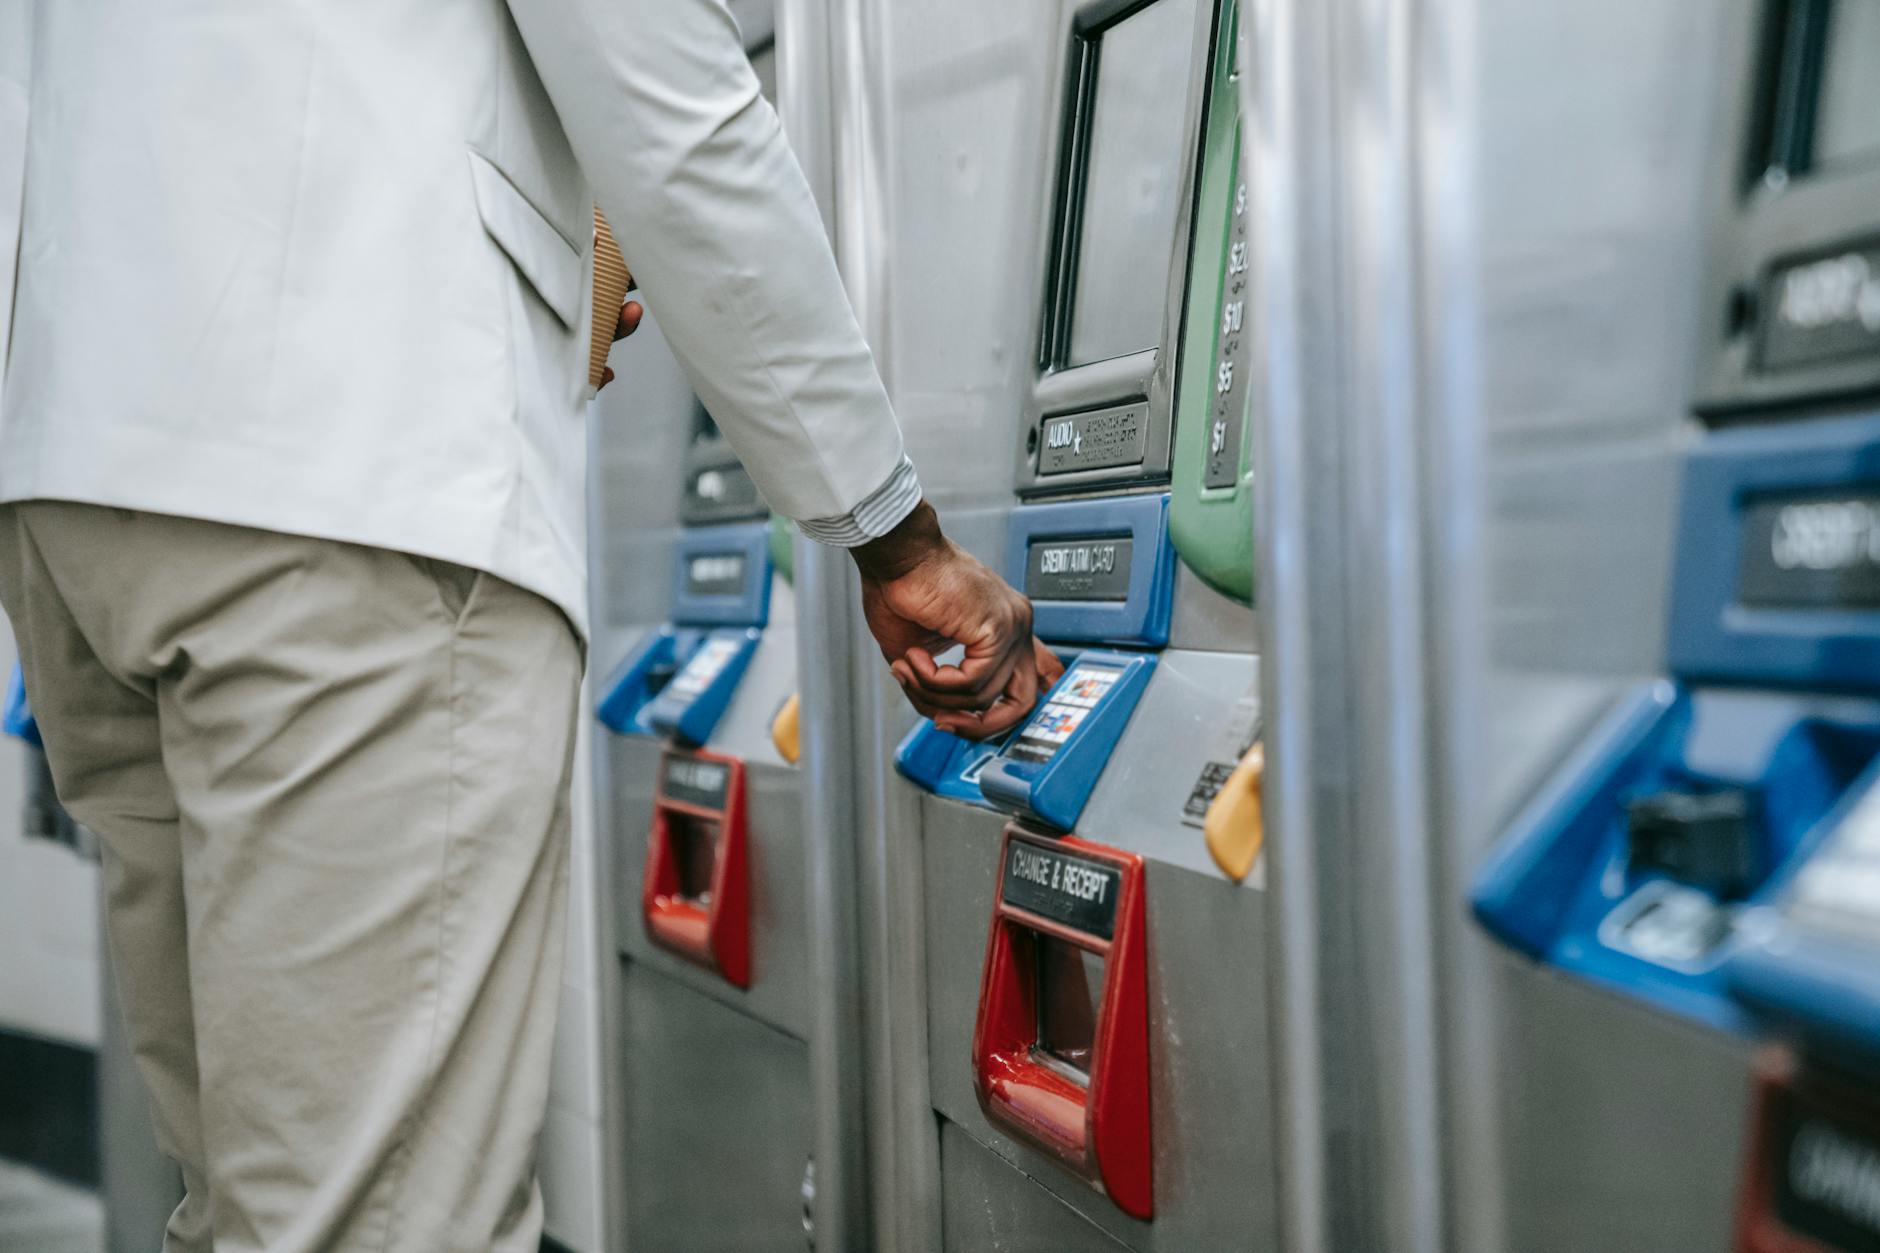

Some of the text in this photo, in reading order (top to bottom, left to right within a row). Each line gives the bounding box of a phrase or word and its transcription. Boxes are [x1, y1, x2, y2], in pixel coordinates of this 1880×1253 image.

[1223, 301, 1243, 335] $10
[1217, 360, 1233, 394] $5
[1047, 421, 1073, 447] AUDIO
[1212, 422, 1227, 452] $1
[1090, 546, 1115, 573] CARD
[1012, 848, 1110, 904] CHANGE & RECEIPT
